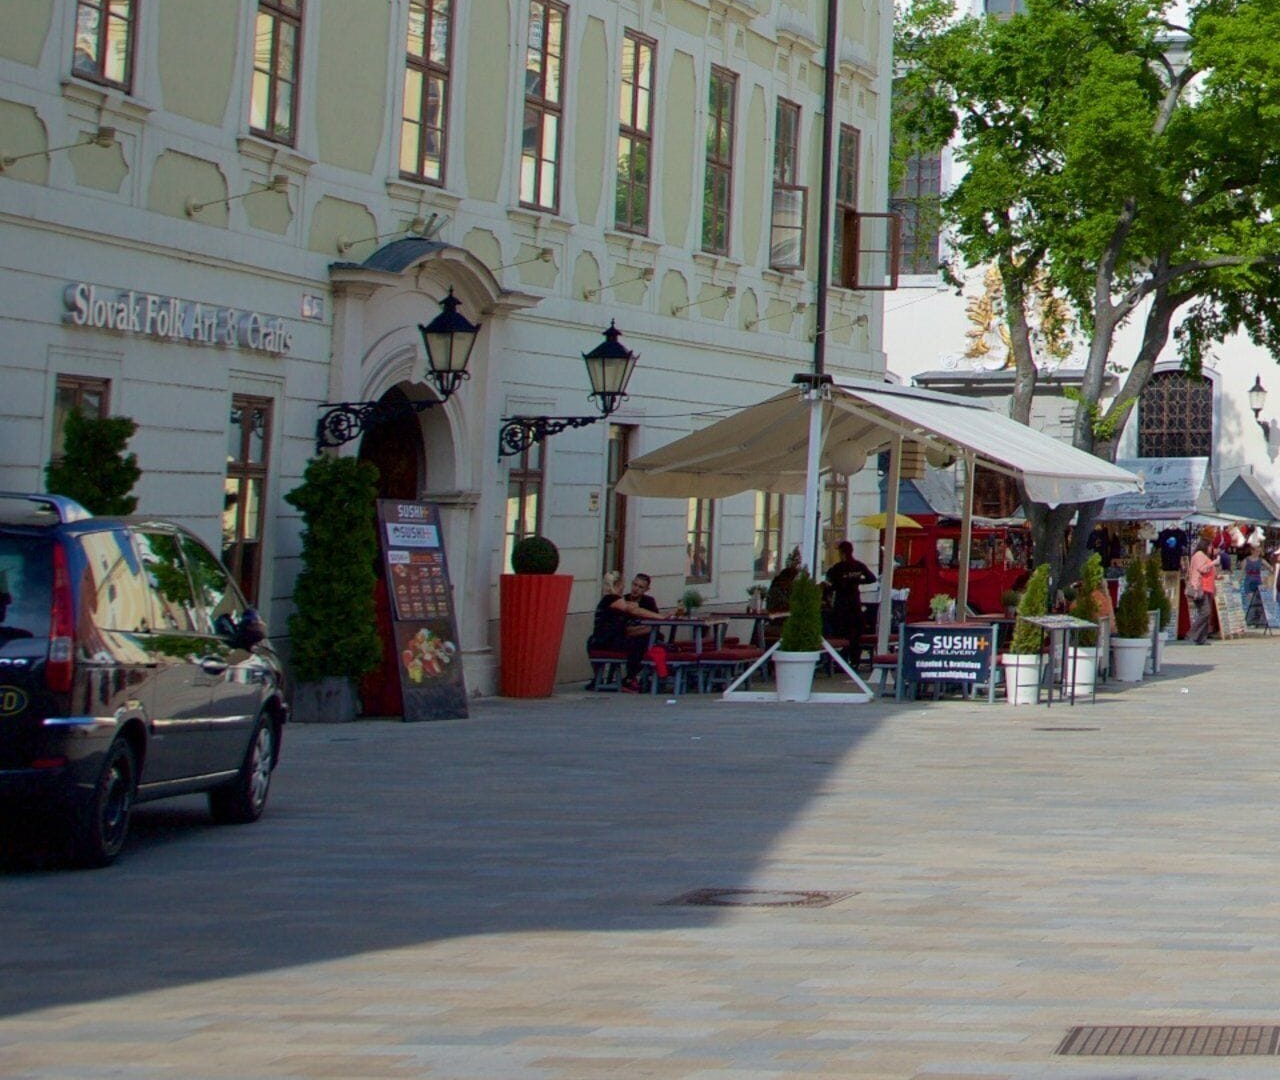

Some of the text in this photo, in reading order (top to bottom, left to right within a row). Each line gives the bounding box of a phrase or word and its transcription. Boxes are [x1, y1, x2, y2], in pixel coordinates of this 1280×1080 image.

[72, 283, 293, 354] Slovak Folk Art & Crafts
[933, 636, 988, 650] SUSHI+
[0, 692, 17, 710] D
